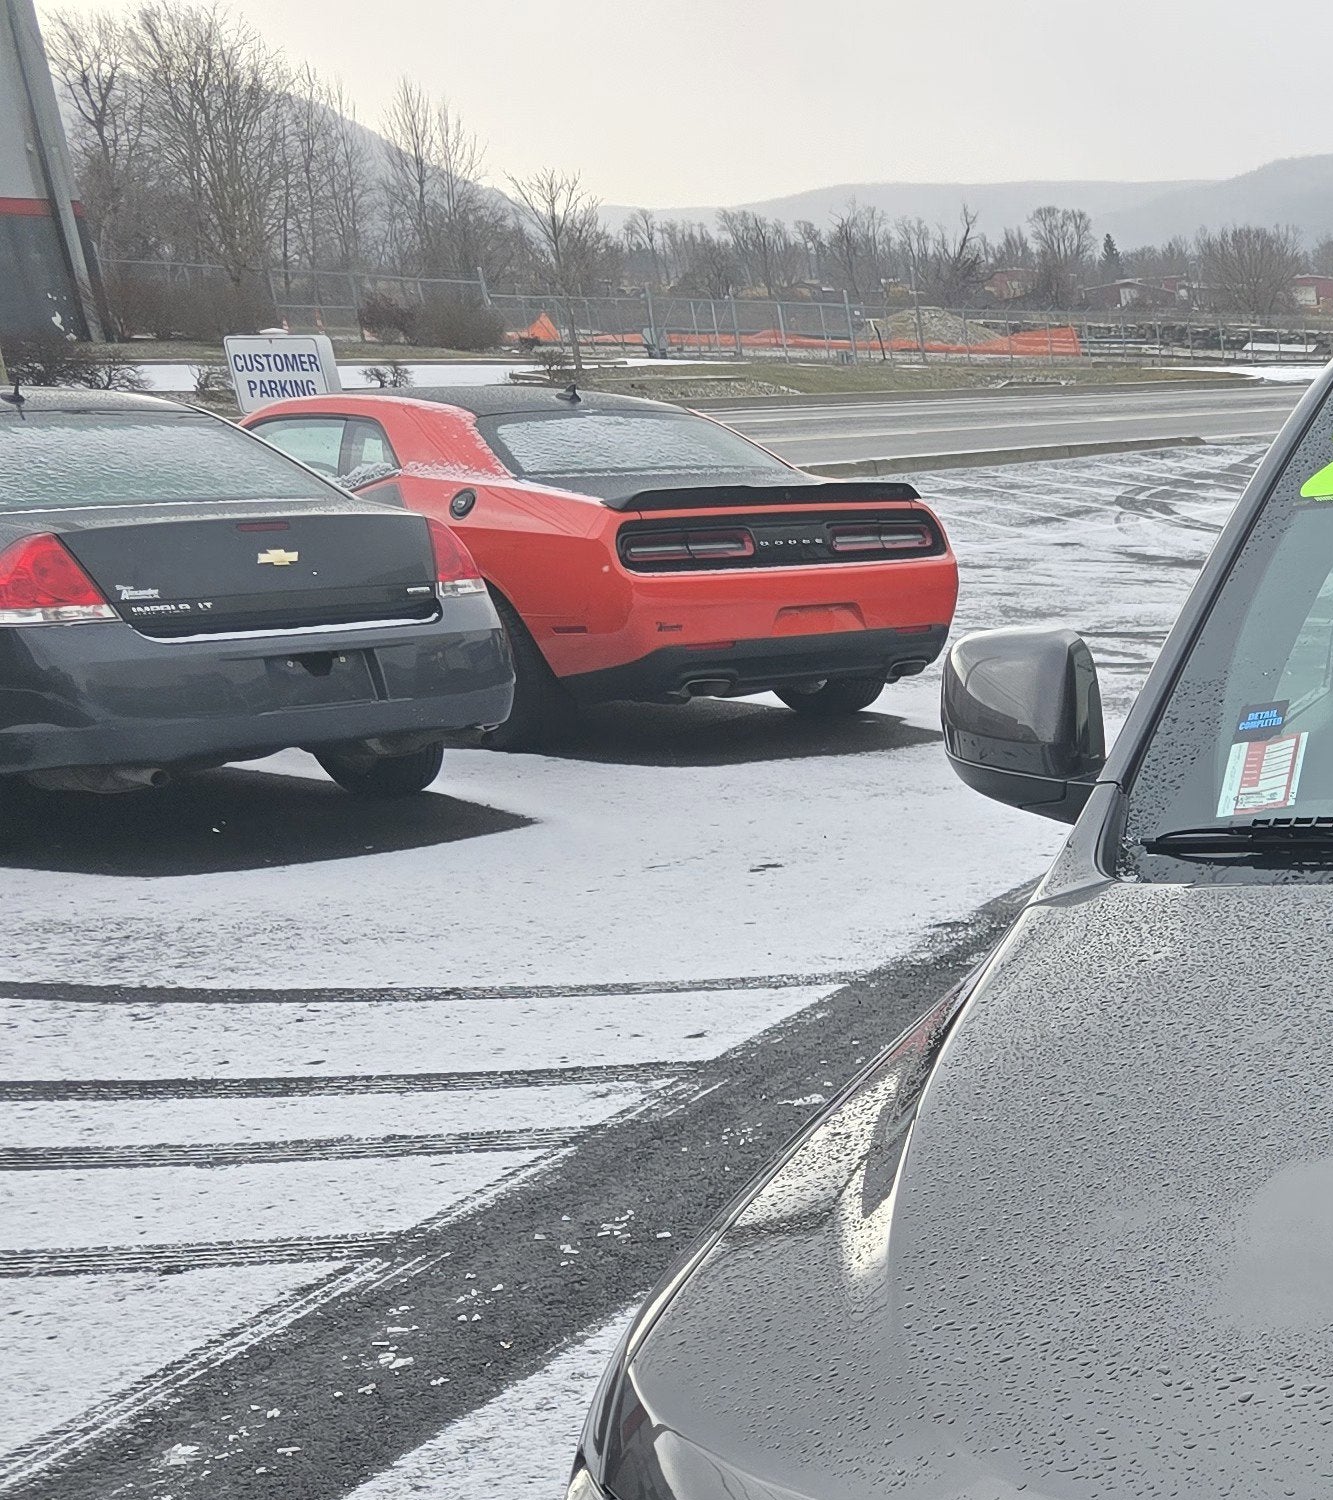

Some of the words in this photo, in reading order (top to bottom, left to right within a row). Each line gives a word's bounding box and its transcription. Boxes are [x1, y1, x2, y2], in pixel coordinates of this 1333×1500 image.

[233, 353, 320, 373] CUSTOMER
[247, 379, 317, 398] PARKING
[760, 538, 823, 547] DODGE
[1247, 709, 1278, 721] DETAIL
[1239, 717, 1282, 731] COMPLETED
